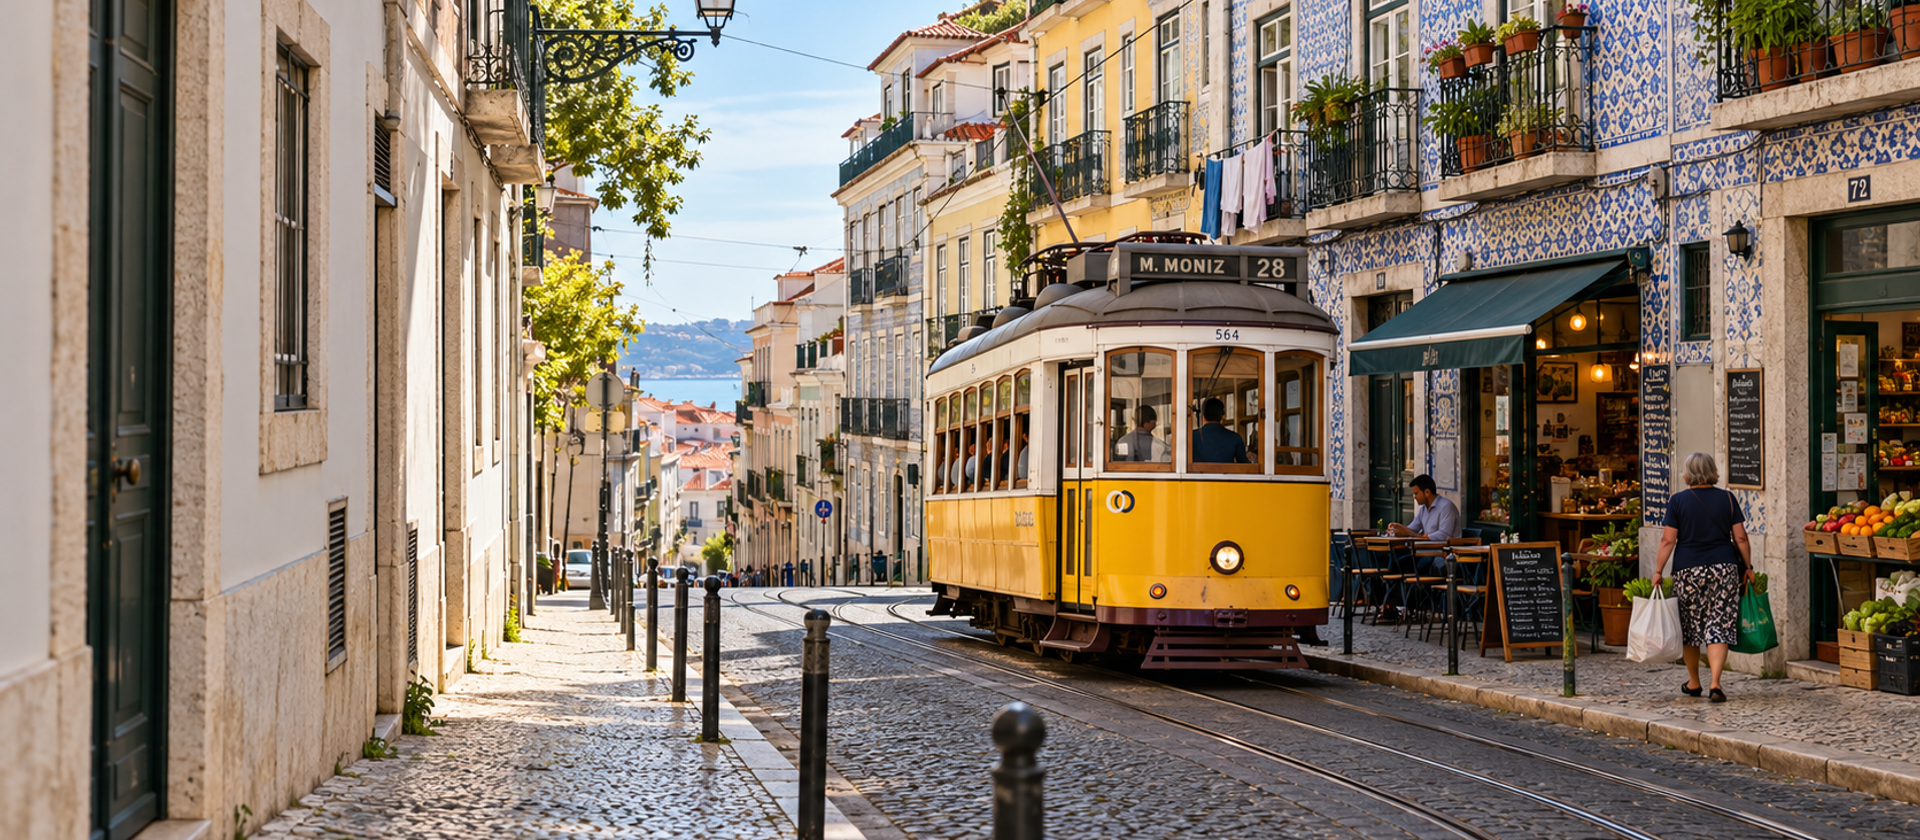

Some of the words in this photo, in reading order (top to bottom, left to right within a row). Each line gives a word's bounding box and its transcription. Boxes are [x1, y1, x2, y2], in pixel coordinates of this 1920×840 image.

[1851, 179, 1867, 199] 72
[1140, 257, 1158, 272] M.
[1164, 258, 1225, 274] MONIZ
[1257, 258, 1285, 278] 28
[1215, 328, 1239, 341] 564
